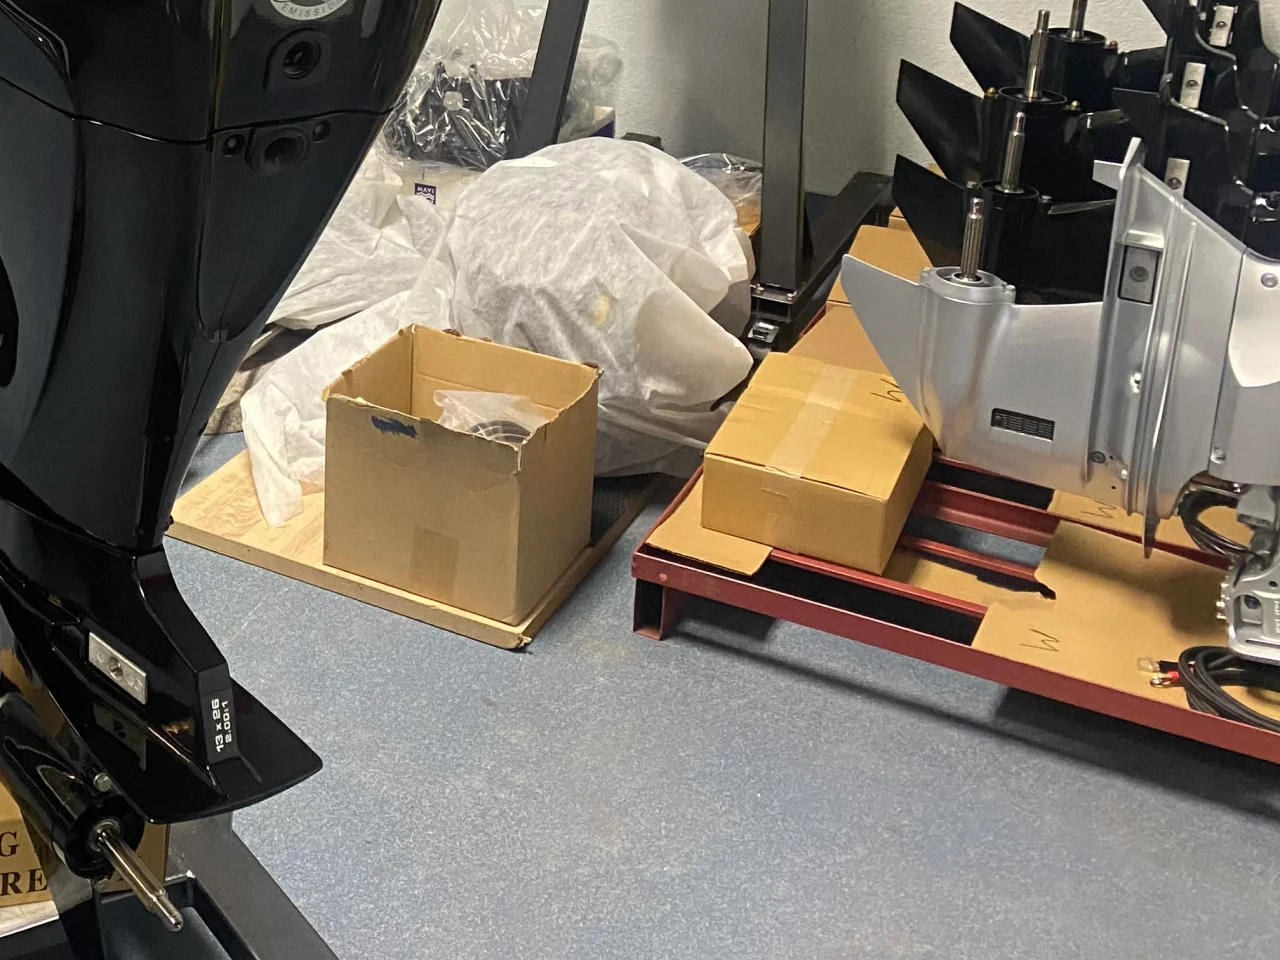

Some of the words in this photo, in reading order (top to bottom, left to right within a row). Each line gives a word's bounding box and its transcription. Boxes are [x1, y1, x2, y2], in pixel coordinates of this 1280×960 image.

[211, 698, 221, 720] 26
[221, 700, 232, 744] 2.00:1
[214, 734, 224, 753] 13
